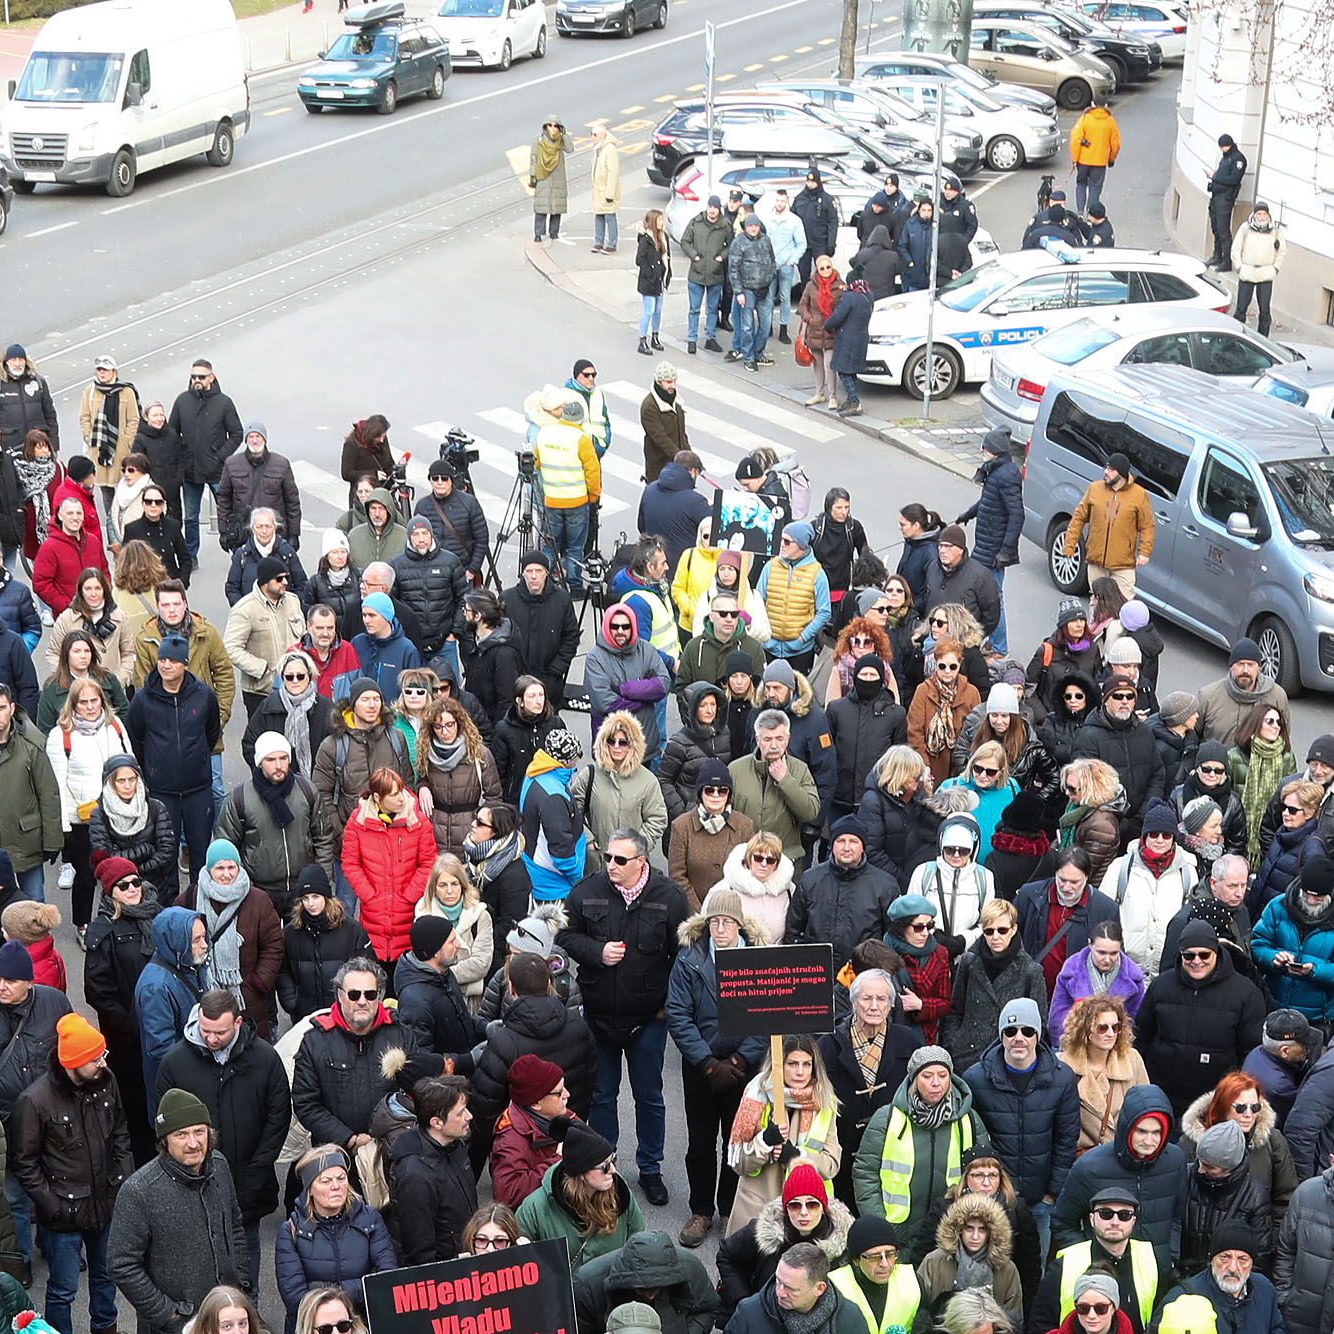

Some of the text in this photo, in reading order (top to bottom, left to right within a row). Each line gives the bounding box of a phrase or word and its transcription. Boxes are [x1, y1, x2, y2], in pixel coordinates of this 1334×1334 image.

[755, 967, 791, 975] značajnih
[720, 980, 755, 988] propusta.
[757, 978, 791, 986] Matijanić
[392, 1261, 540, 1314] Mijenjamo
